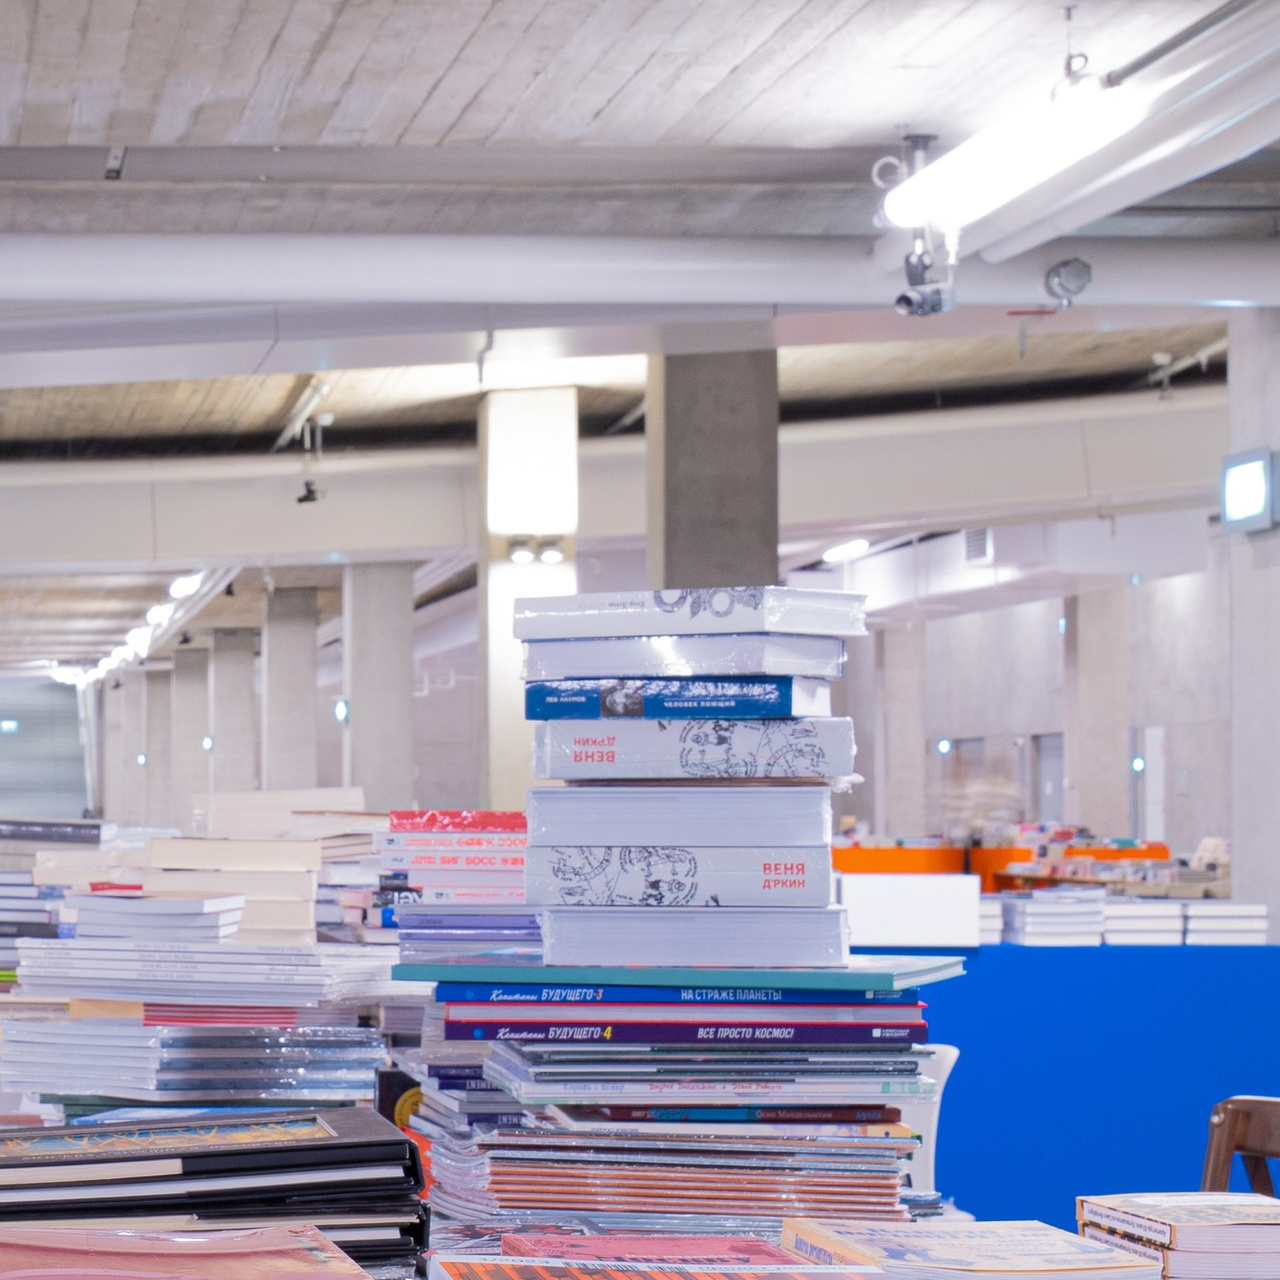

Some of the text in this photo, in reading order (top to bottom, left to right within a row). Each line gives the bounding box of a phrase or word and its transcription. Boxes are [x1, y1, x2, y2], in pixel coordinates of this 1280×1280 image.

[700, 700, 736, 708] ПОЮЩИЙ
[573, 750, 616, 763] ВЕНЯ
[762, 862, 806, 875] ВЕНЯ
[489, 989, 782, 1001] Капитаны БУДУЩЕГО-3 НА СТРАЖЕ ПЛАНЕТЫ
[496, 1026, 794, 1040] Капитаны БУДУЩЕГО-4 ВСЕ ПРОСТО КОСМОС!
[778, 1110, 833, 1119] Мандельштам
